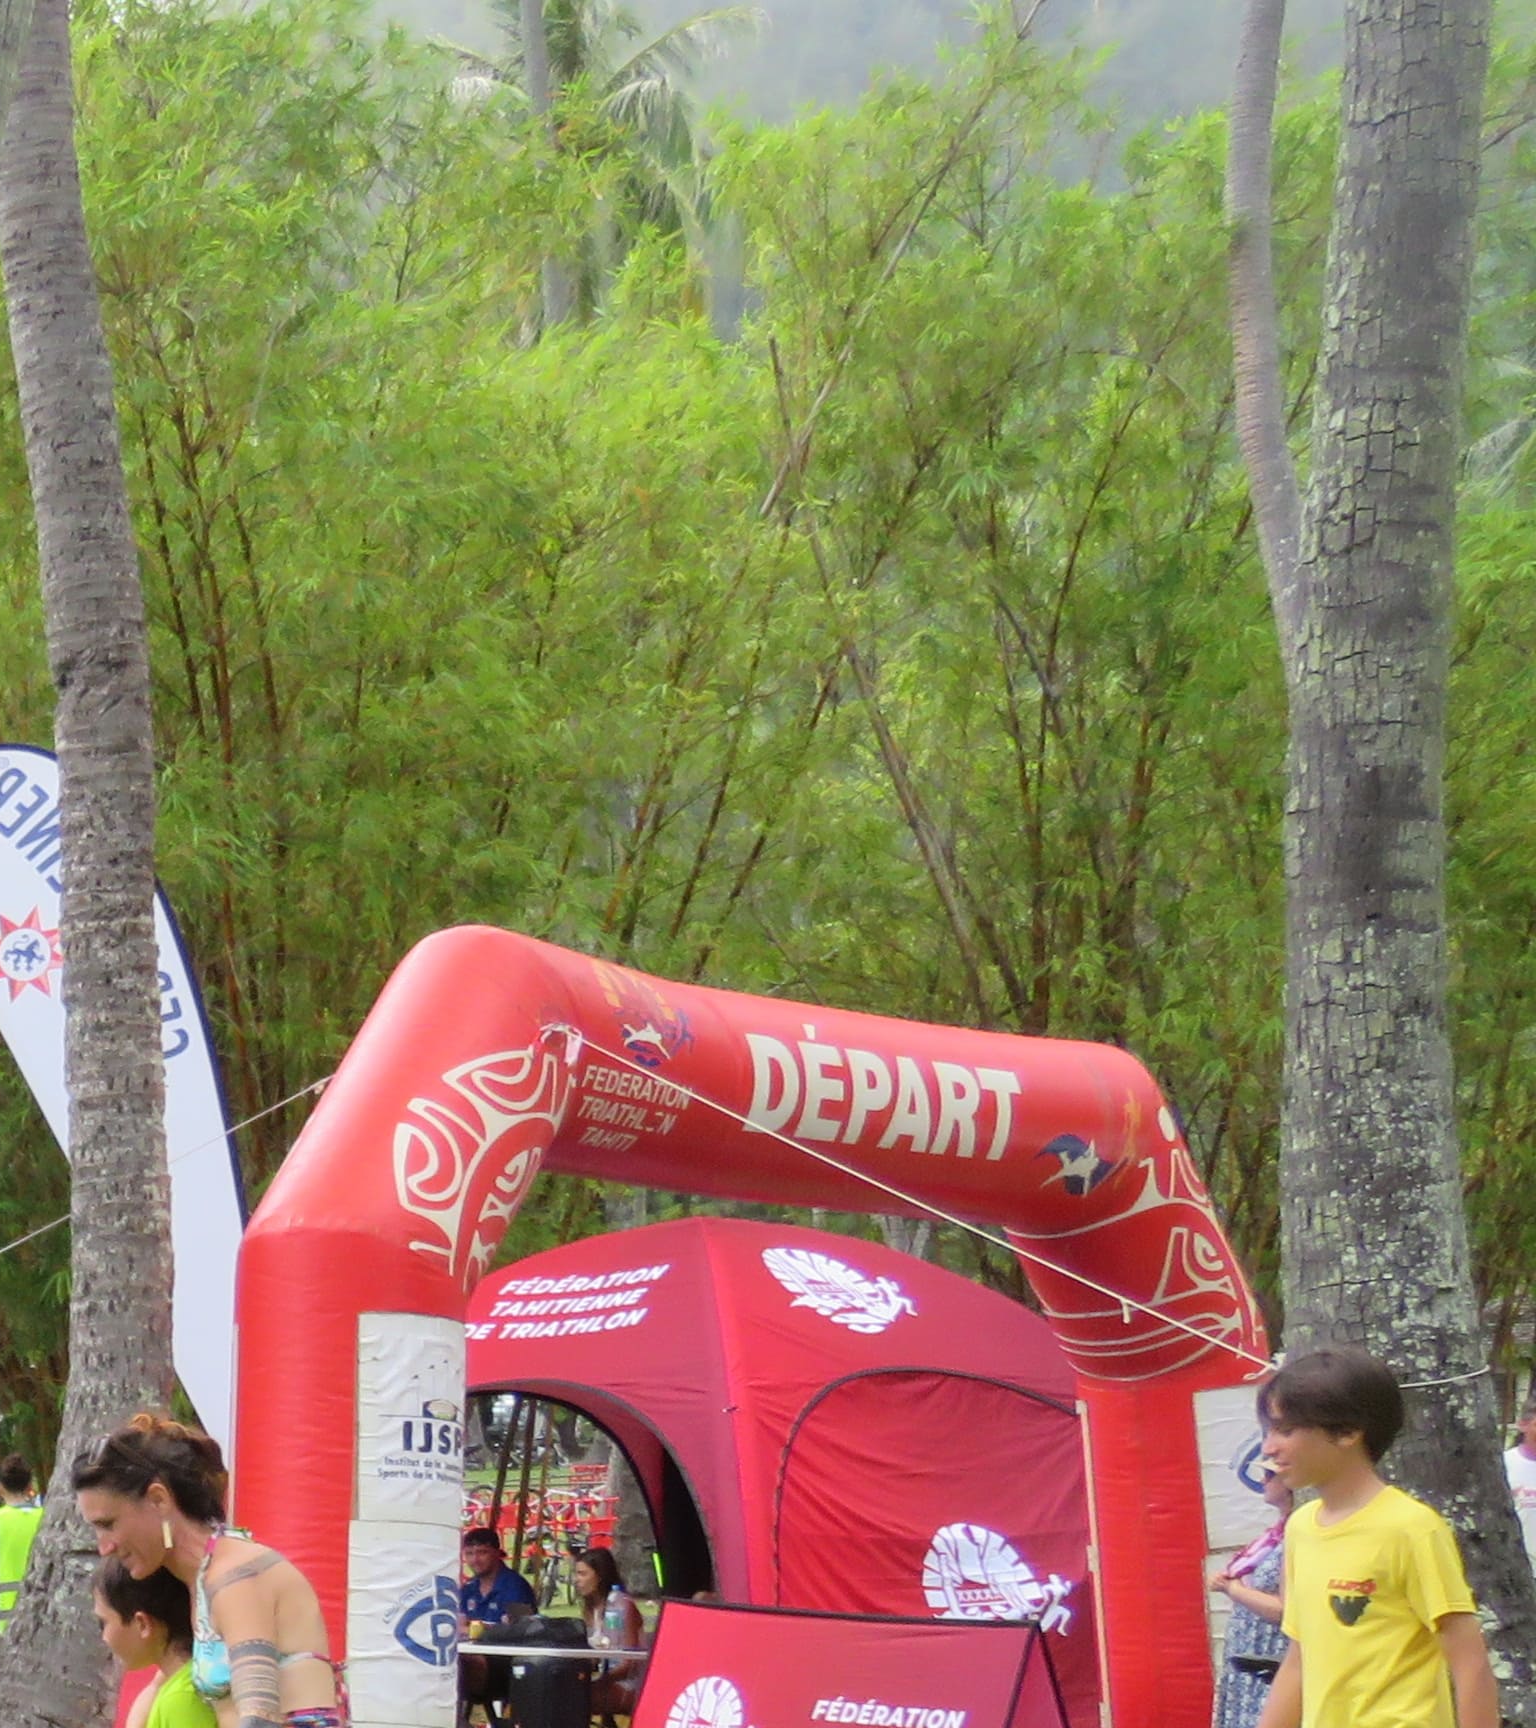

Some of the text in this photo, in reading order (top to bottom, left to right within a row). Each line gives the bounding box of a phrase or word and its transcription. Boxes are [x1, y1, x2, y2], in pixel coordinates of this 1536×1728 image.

[742, 1023, 1022, 1161] DÉPART
[498, 1263, 671, 1296] FÉDÉRATION
[489, 1287, 648, 1317] TAHITIENNE
[498, 1307, 649, 1340] TRIATHLON
